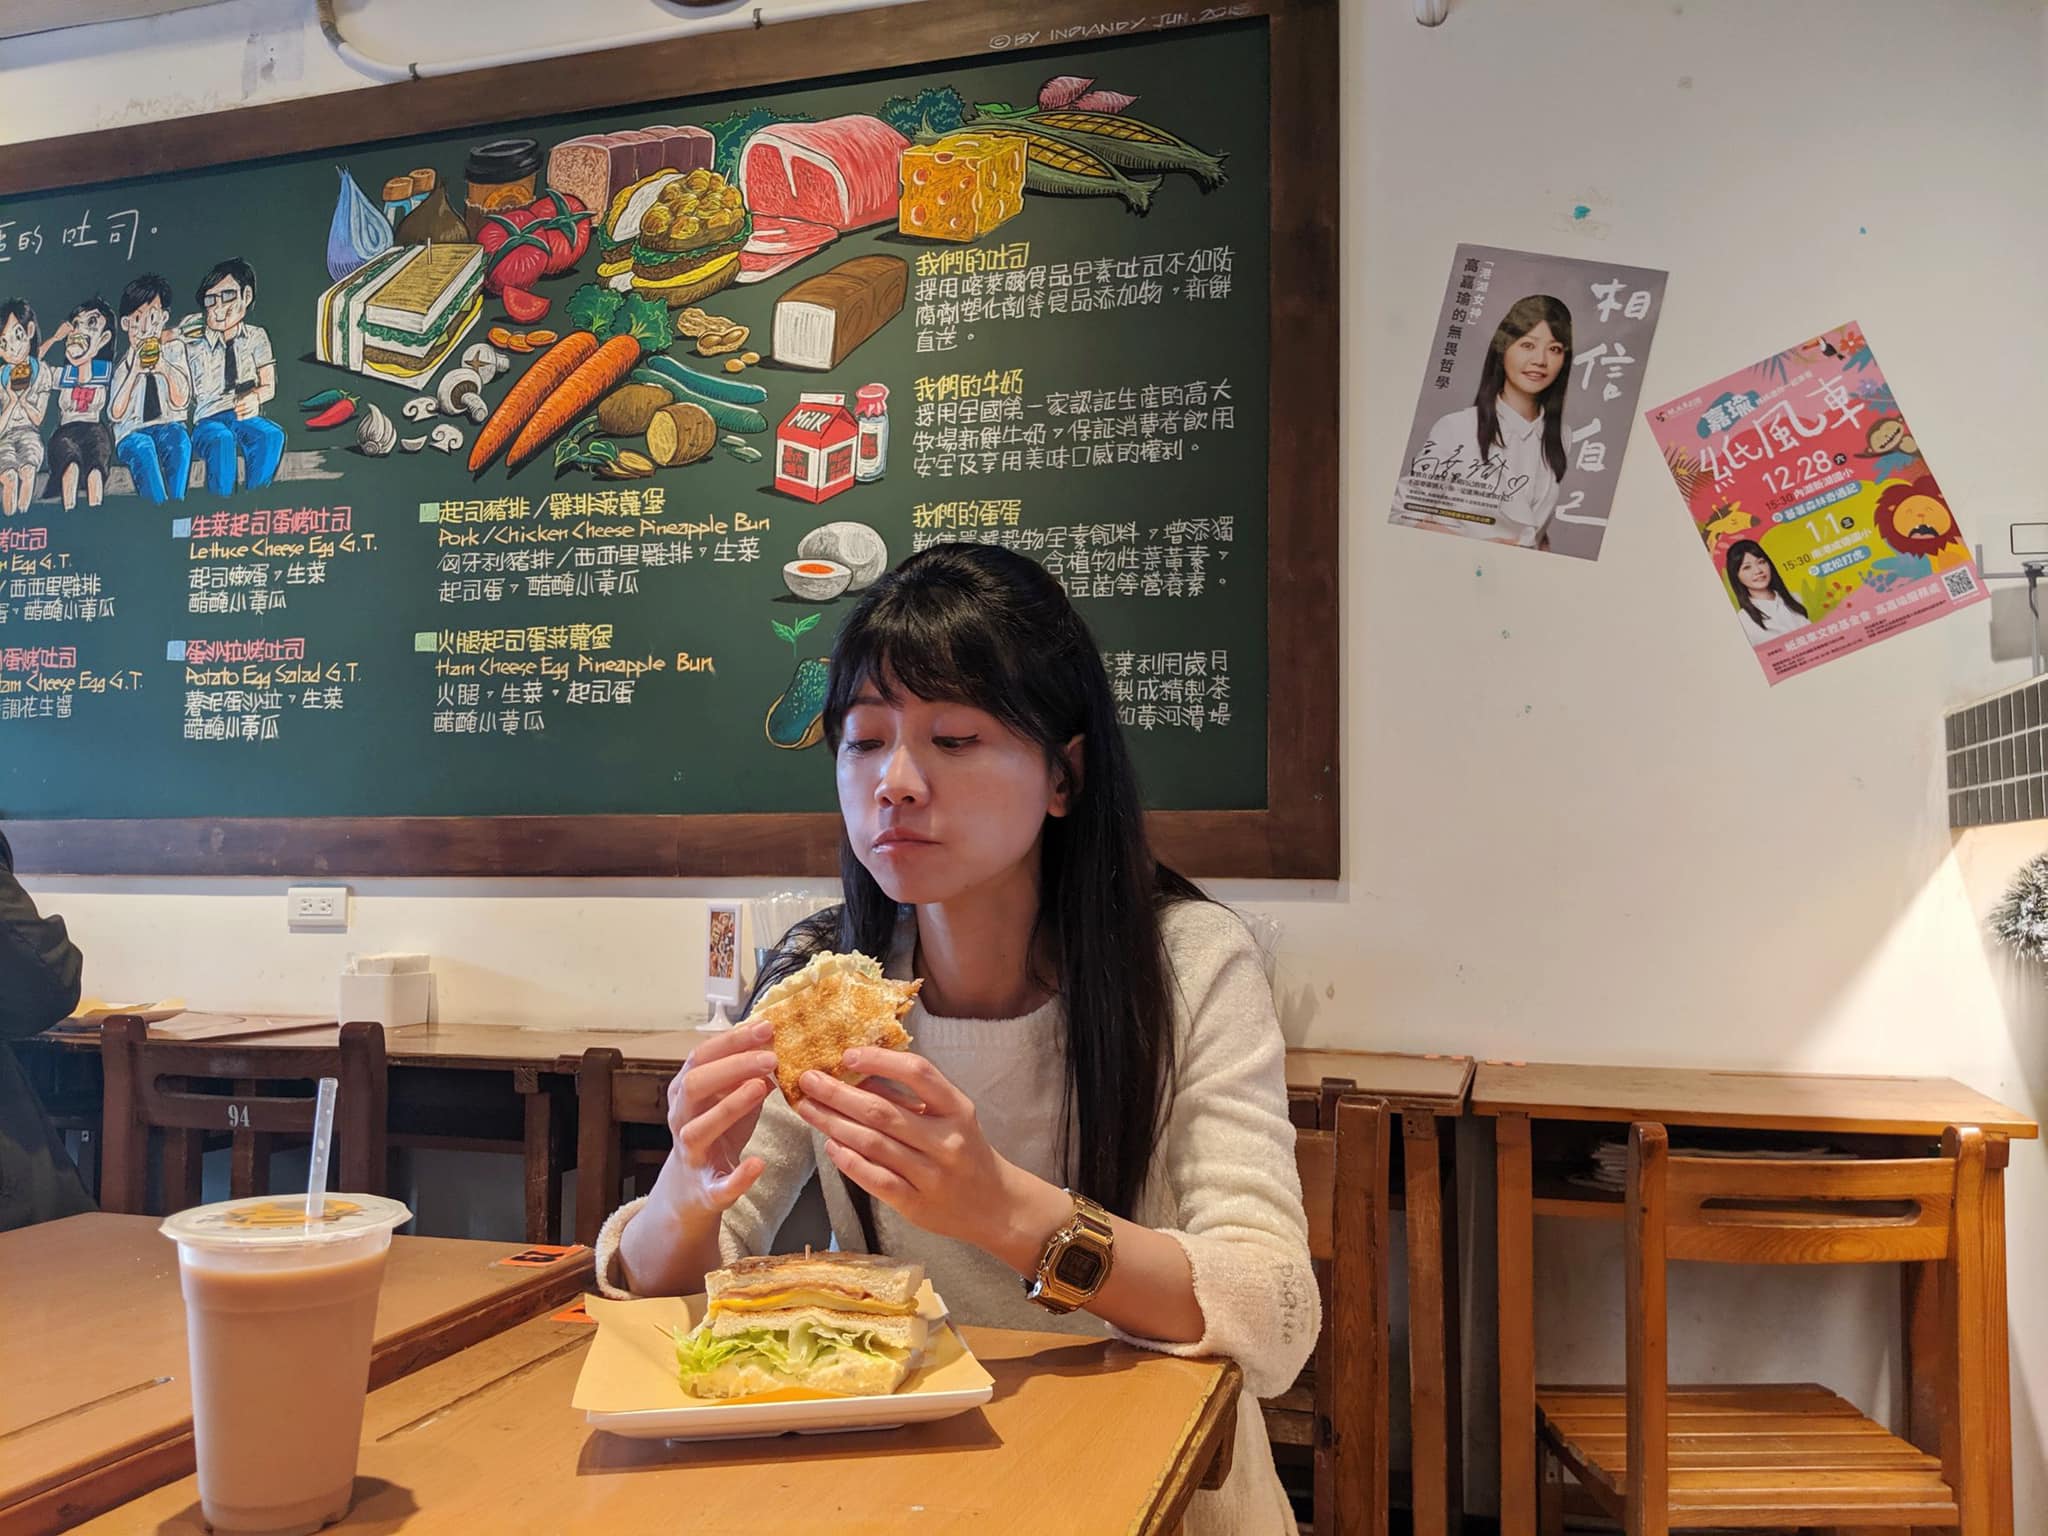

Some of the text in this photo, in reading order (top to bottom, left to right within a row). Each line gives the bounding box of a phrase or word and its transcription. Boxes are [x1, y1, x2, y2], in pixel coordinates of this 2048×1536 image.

[915, 241, 1030, 276] 我們的吐司
[1433, 257, 1481, 391] 高嘉瑜的無畏哲學
[916, 325, 975, 353] 直送。
[913, 368, 1024, 401] 我們的牛奶
[1554, 278, 1652, 527] 相信自己
[1702, 393, 1754, 434] 嘉瑜
[1699, 374, 1864, 494] 紙風車
[1762, 449, 1834, 495] 12/28
[191, 506, 352, 538] 生菜起司蛋烤吐司
[572, 521, 635, 540] Cheese
[640, 514, 728, 541] Pineapple
[734, 512, 770, 531] Bun
[912, 499, 1022, 529] 我們的蛋蛋
[190, 533, 378, 560] Lettuce Cheese Egg G.T.
[11, 553, 36, 575] Egg
[438, 568, 640, 603] 起司蛋，醋醃小黃瓜
[188, 589, 287, 615] 醋醃小黃瓜
[186, 637, 305, 665] 蛋沙拉烤吐司
[438, 622, 613, 655] 火腿起司蛋菠蘿堡
[0, 646, 76, 672] 蛋烤吐司
[435, 652, 715, 681] Ham Cheese Egg Pineapple Bun
[26, 671, 75, 694] Cheese
[79, 671, 106, 693] Egg
[185, 661, 361, 690] Potato Egg Salad G.T.
[184, 714, 280, 742] 醋醃小黃瓜
[433, 709, 545, 736] 醋醃小黃瓜
[228, 1104, 250, 1127] 94
